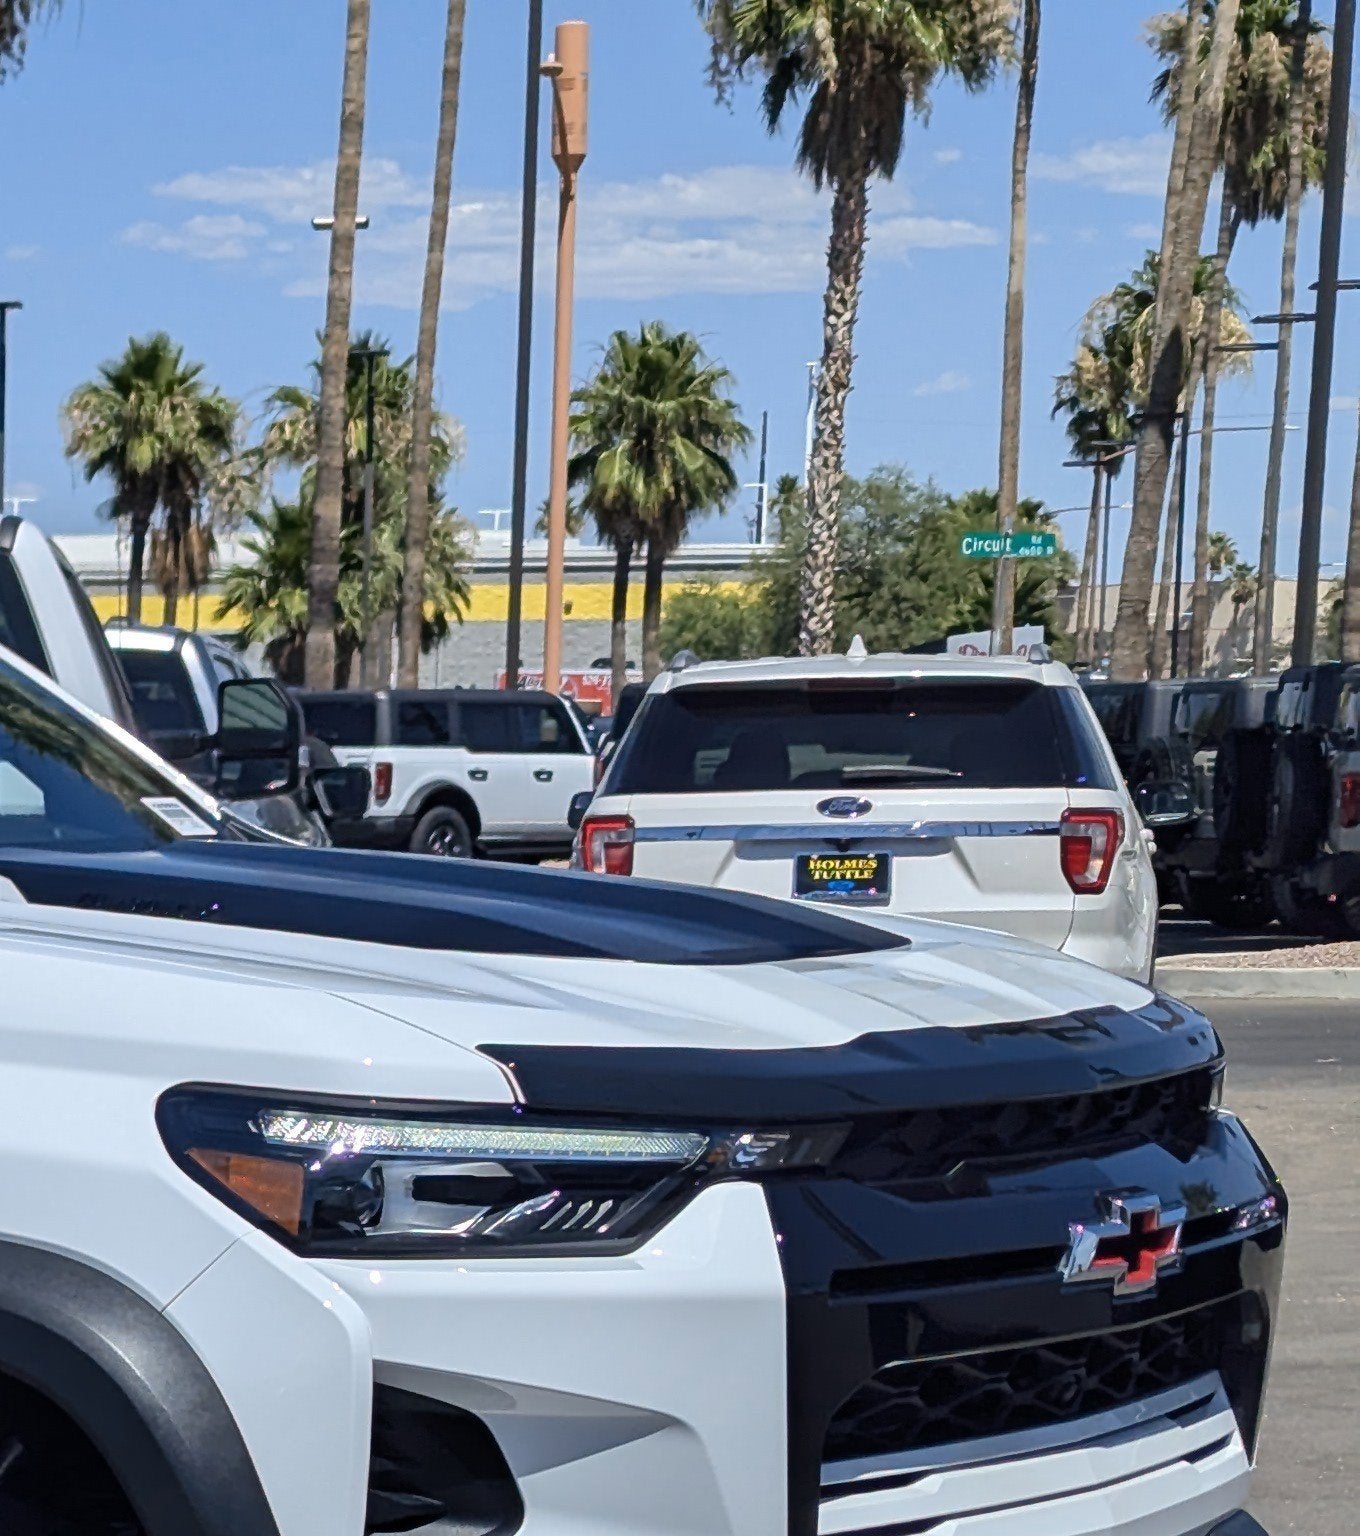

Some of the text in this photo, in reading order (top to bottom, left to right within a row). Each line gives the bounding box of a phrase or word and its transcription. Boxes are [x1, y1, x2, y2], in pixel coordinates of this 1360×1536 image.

[962, 537, 1012, 555] Circuit
[809, 859, 877, 870] HOLMES
[811, 870, 874, 880] TUTTLE
